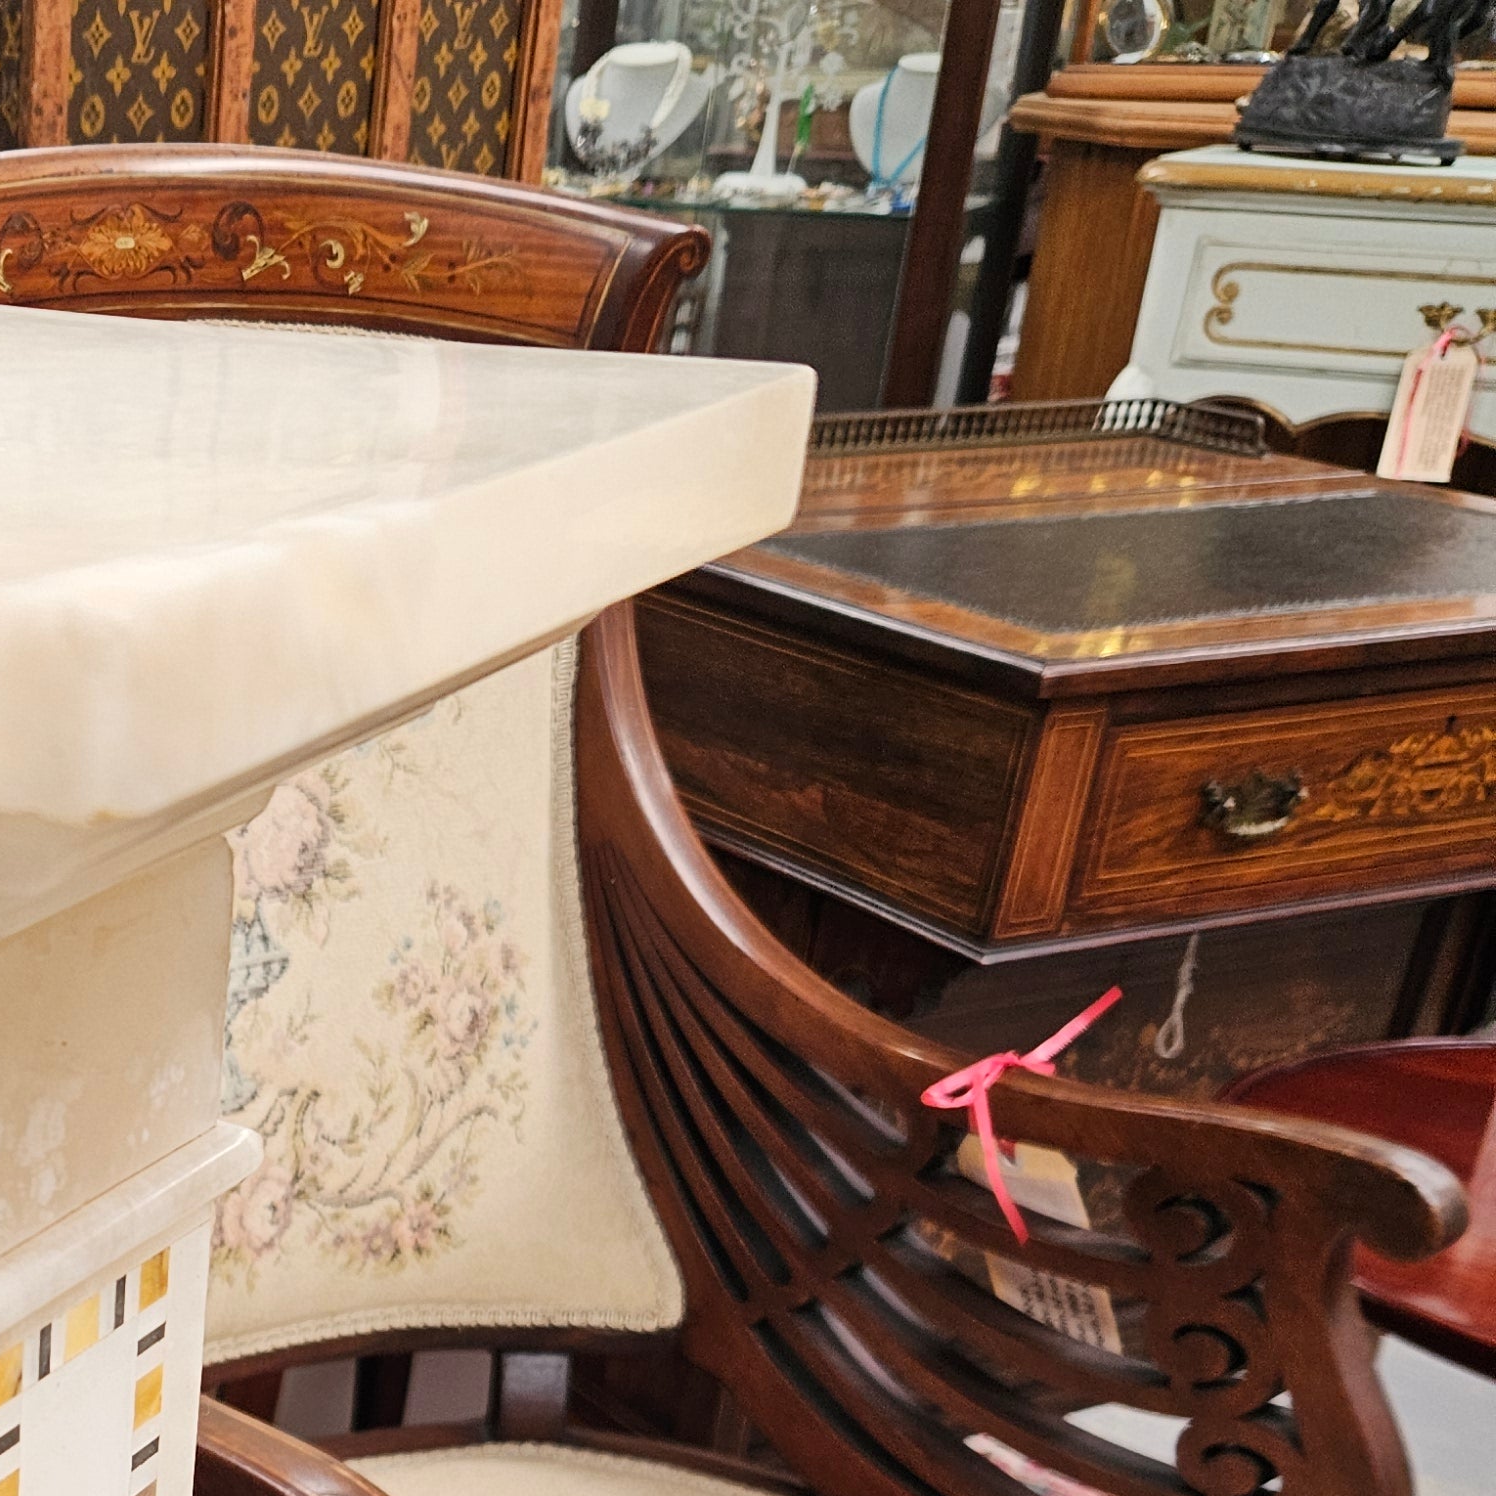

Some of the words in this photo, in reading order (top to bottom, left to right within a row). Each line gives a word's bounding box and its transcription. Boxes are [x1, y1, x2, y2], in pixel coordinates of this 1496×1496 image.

[129, 10, 160, 64] LV
[301, 5, 329, 58] LV
[453, 2, 478, 49] LV
